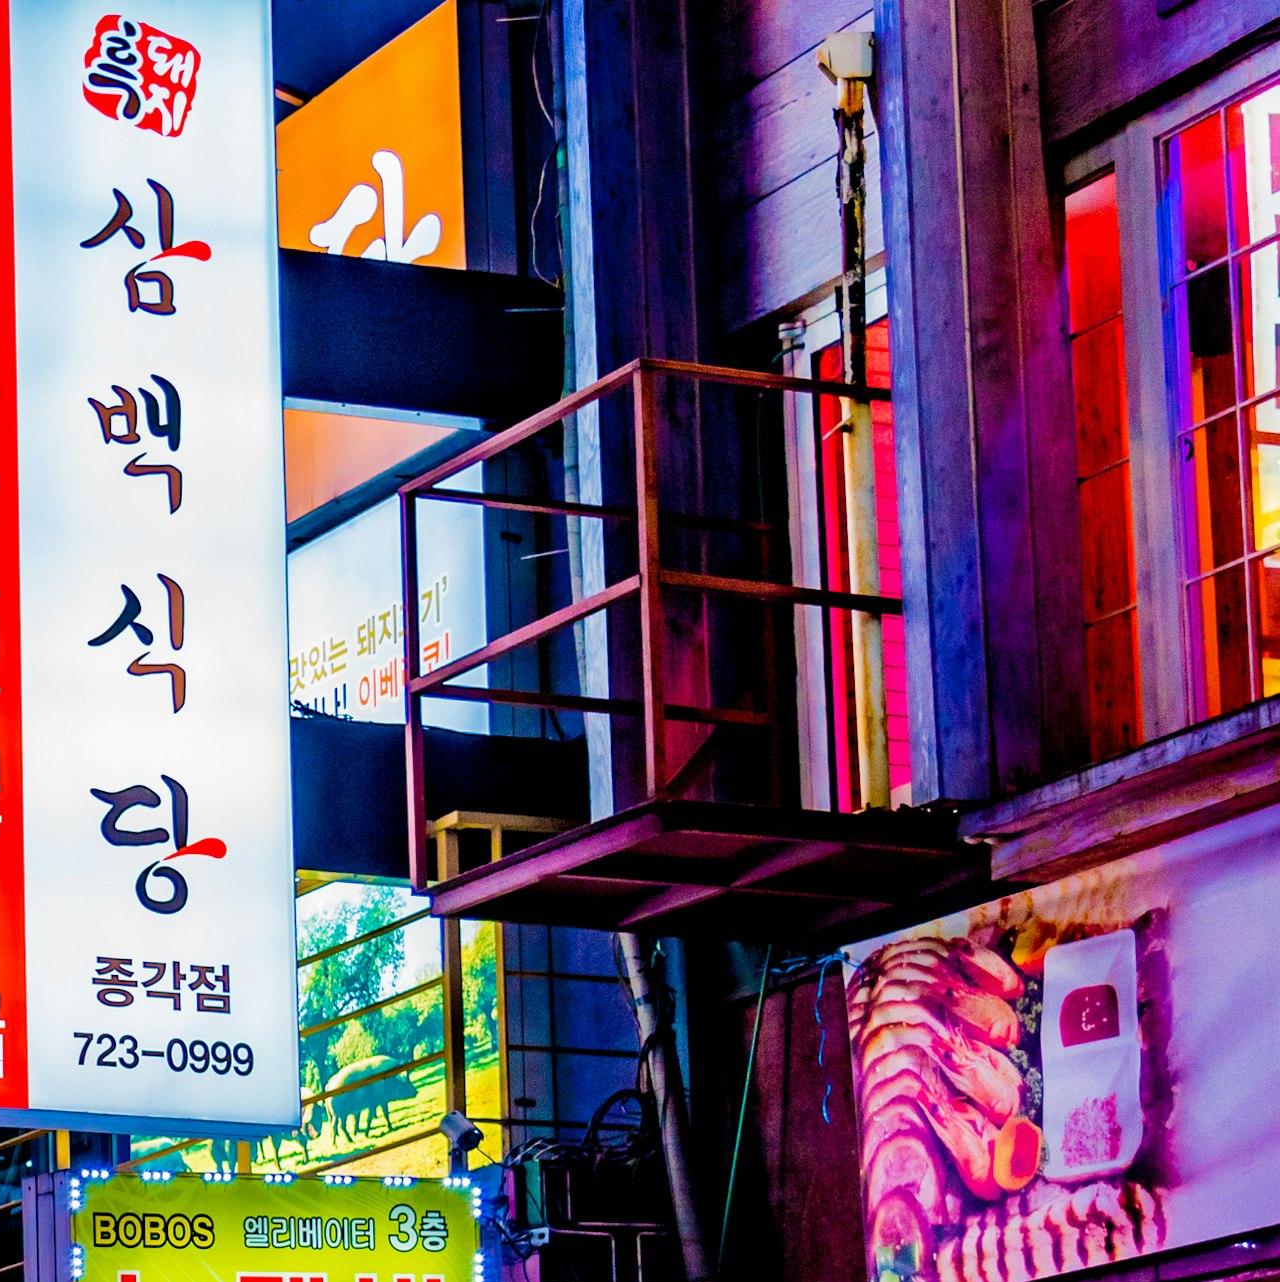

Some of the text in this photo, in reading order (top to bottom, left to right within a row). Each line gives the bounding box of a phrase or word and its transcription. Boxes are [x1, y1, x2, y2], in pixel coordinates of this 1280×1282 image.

[79, 178, 228, 914] 삼백식당
[91, 955, 232, 1014] 종각점
[73, 1032, 255, 1077] 723-0999
[92, 1204, 449, 1252] BOBOS 엘리베이터 3층
